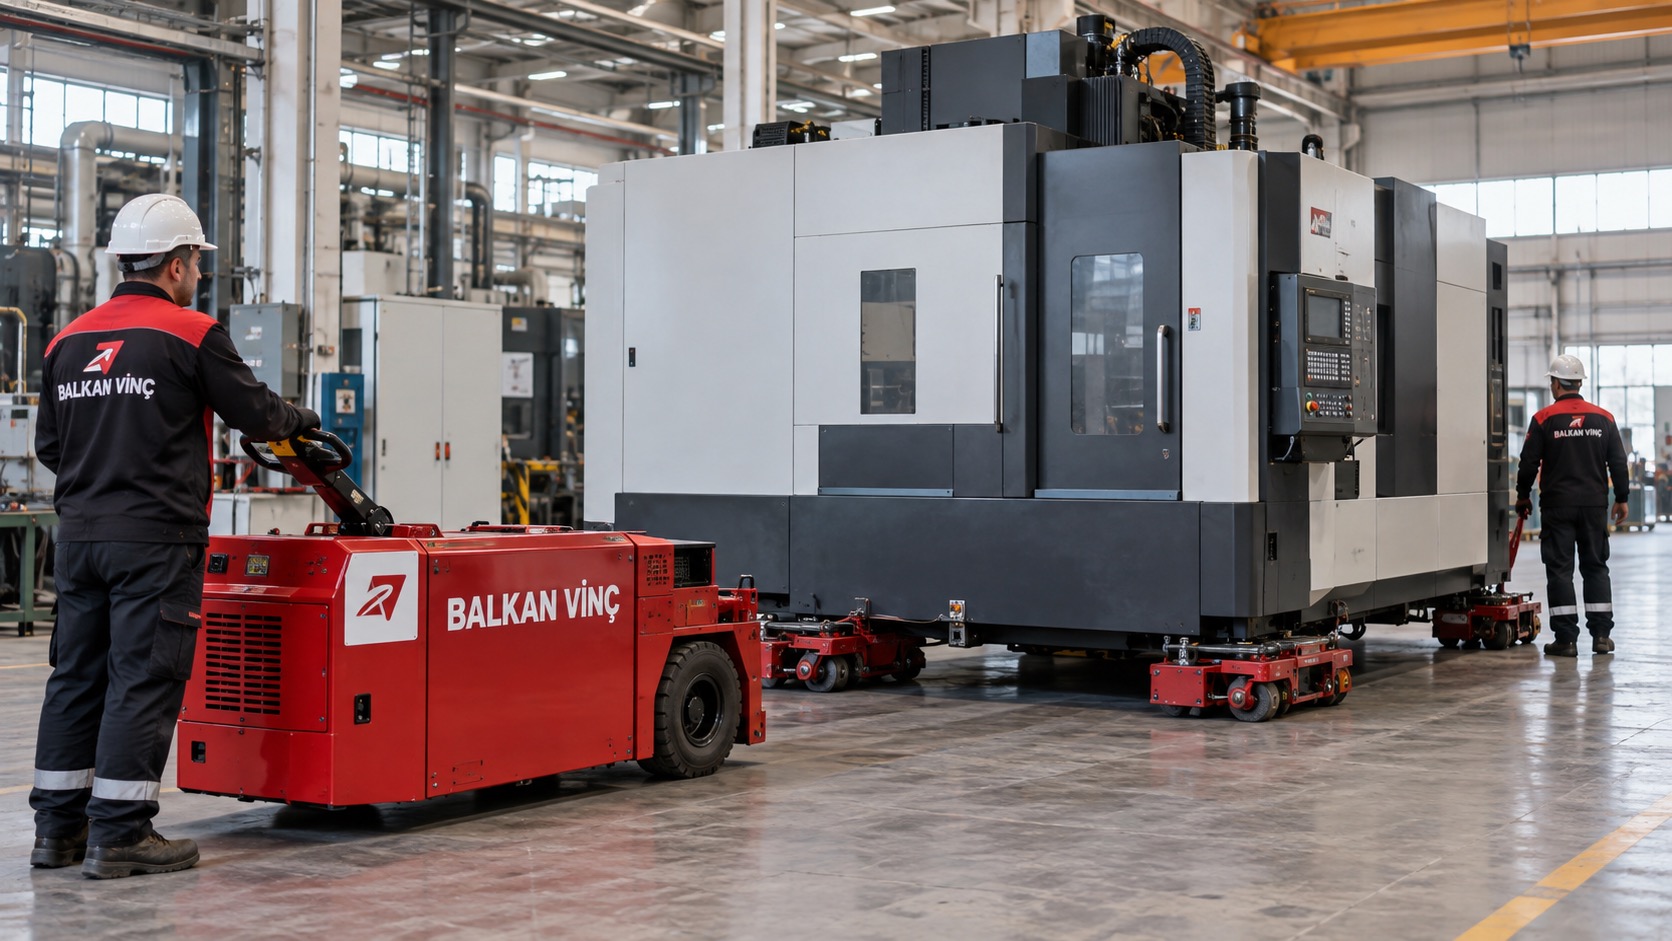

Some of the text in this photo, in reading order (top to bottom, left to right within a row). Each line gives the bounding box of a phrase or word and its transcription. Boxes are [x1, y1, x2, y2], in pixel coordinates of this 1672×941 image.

[58, 373, 156, 401] BALKAN VİNÇ
[1554, 429, 1584, 438] BALKAN
[447, 579, 620, 632] BALKAN VİNÇ
